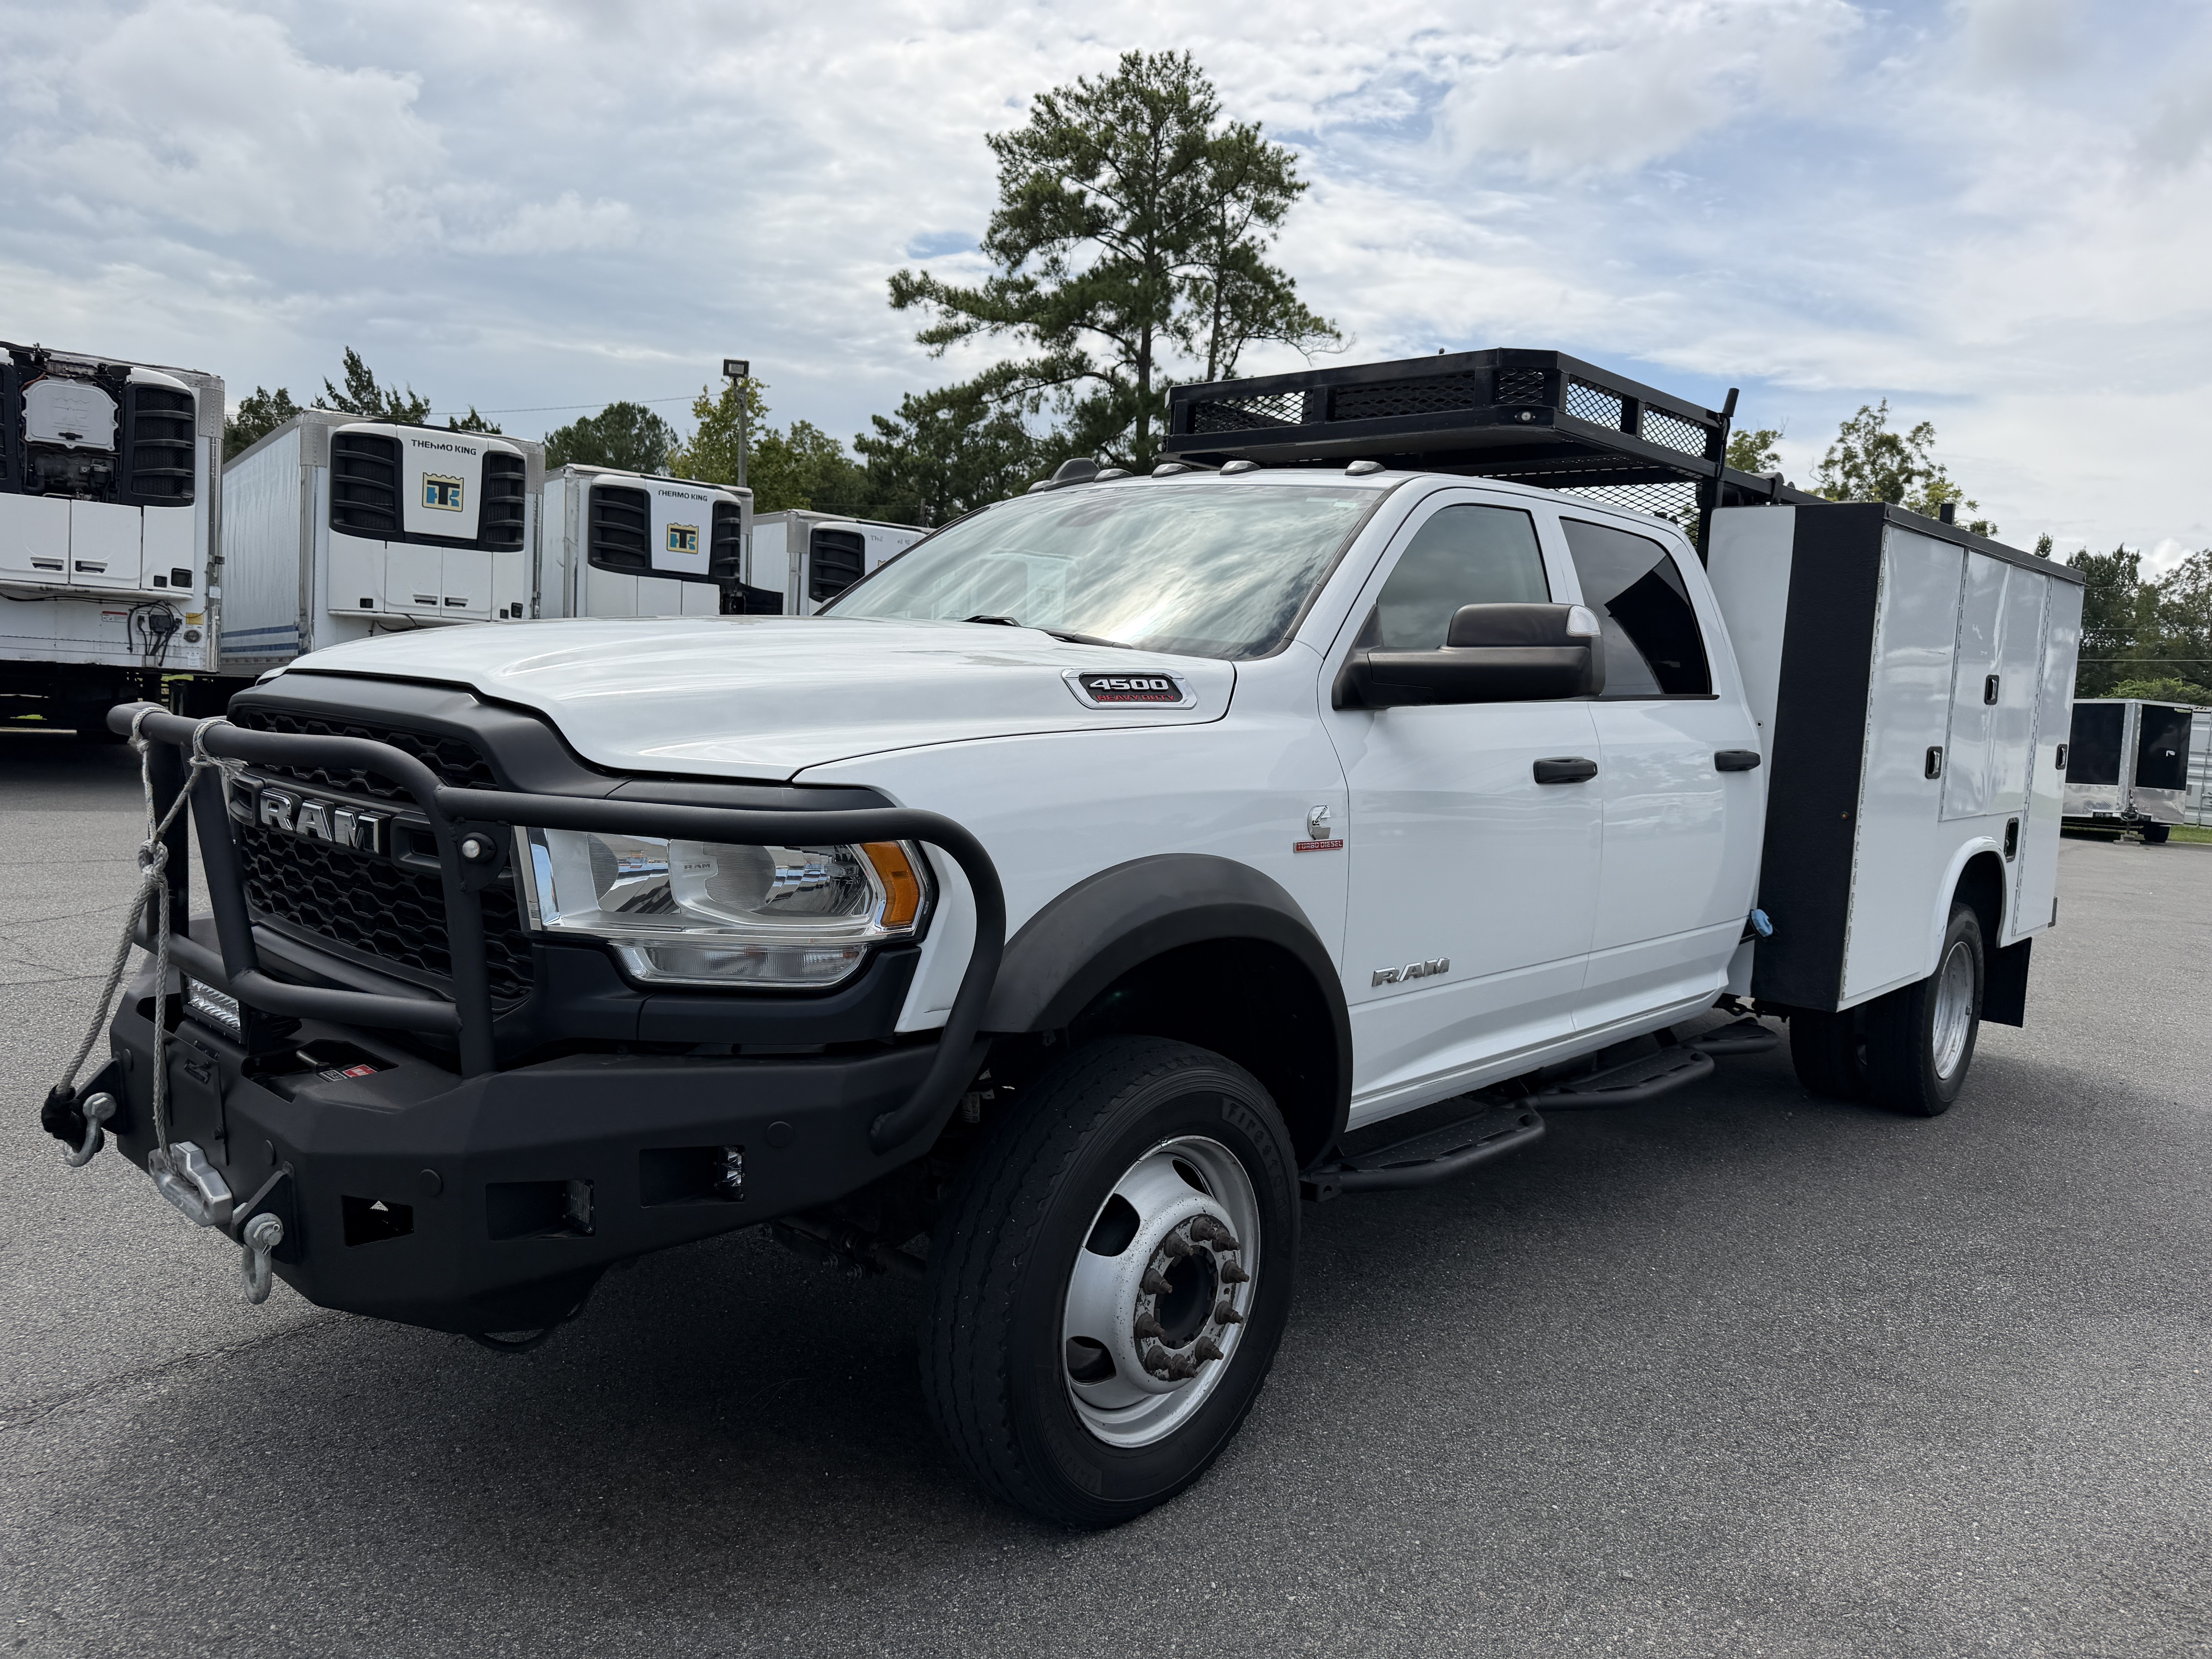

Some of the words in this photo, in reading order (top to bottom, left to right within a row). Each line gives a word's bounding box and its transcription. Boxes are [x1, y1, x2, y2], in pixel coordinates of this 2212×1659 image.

[411, 439, 453, 451] THERMO
[455, 445, 477, 455] KING
[658, 489, 689, 499] THERMO
[1088, 679, 1169, 691] 4500
[260, 788, 380, 854] RAM
[1320, 840, 1343, 848] DIESEL
[1372, 957, 1450, 987] RAM
